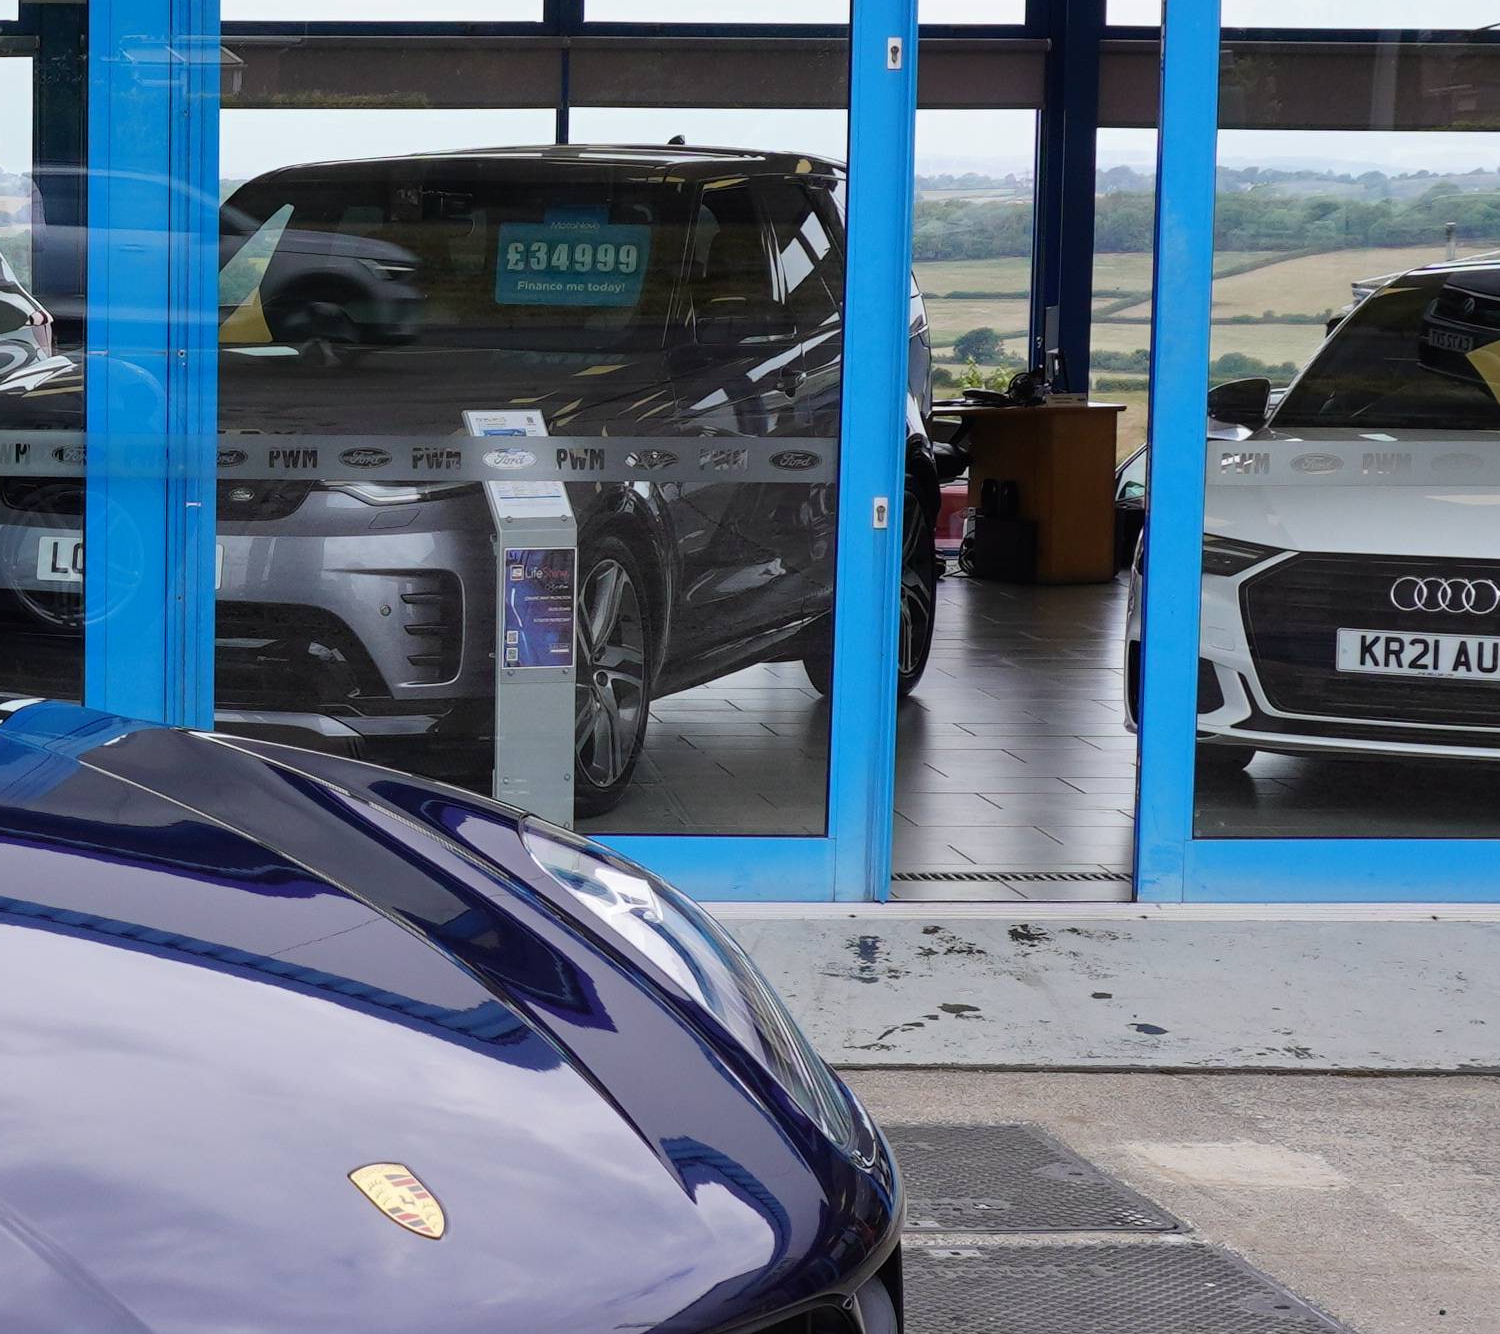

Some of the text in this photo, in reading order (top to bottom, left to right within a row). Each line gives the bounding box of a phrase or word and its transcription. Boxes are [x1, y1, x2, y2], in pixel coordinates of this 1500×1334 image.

[507, 241, 638, 274] £34999
[517, 280, 626, 294] Finance me today!
[268, 448, 319, 469] PWM
[412, 447, 462, 470] PWM
[555, 448, 606, 471] PWM
[1359, 634, 1440, 671] KR21
